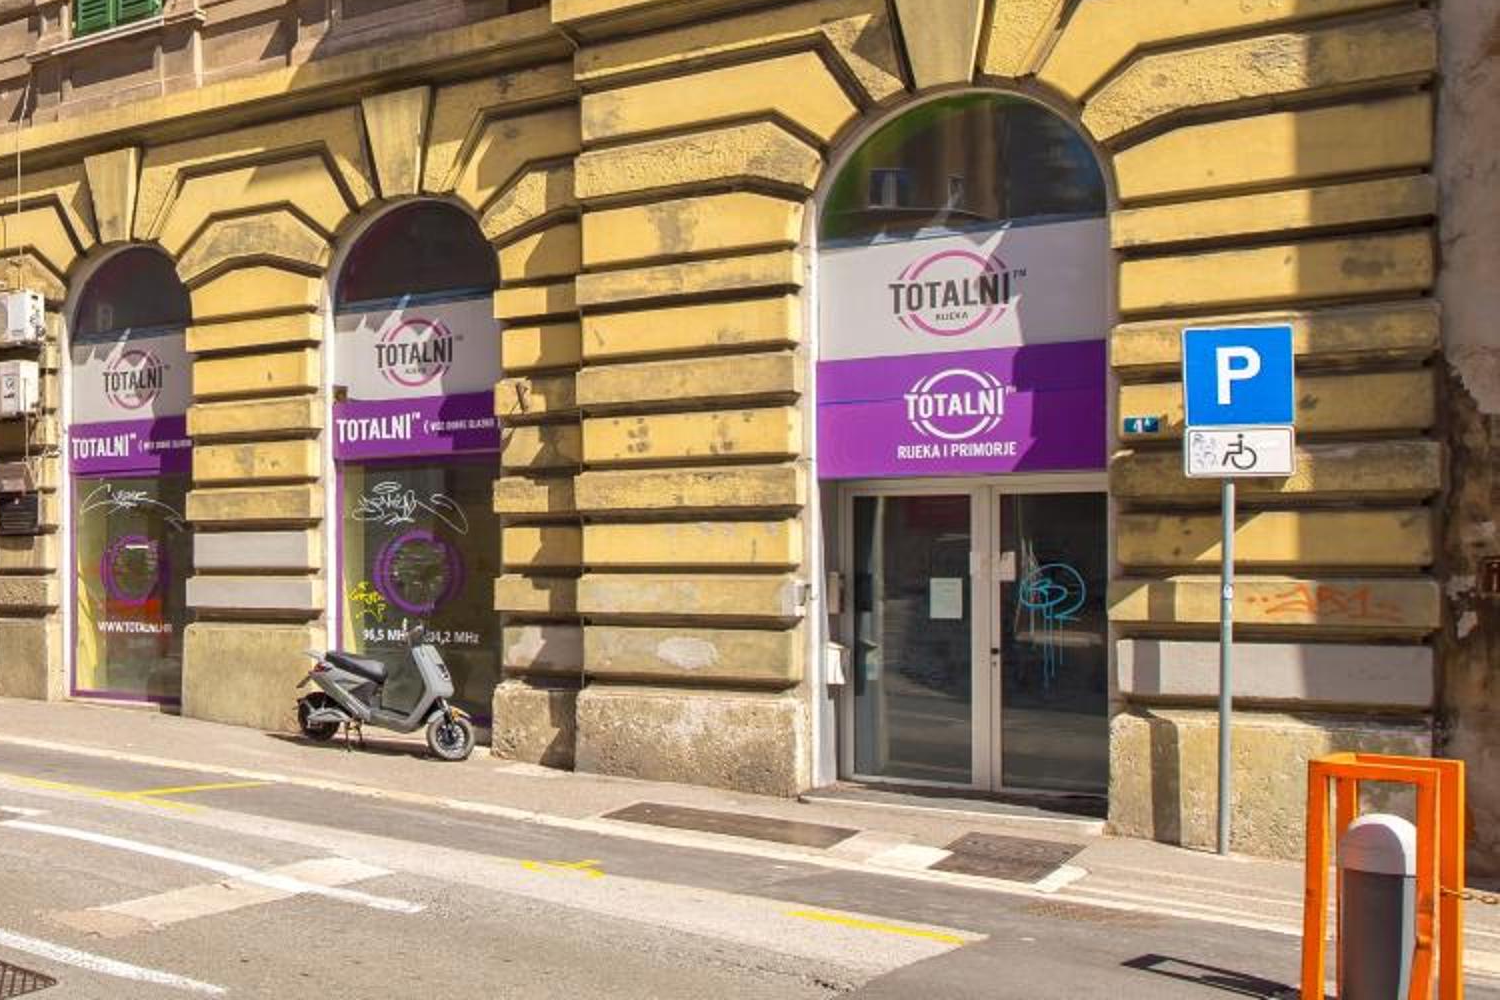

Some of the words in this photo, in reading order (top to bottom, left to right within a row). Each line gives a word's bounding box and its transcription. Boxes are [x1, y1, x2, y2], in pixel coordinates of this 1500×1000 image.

[889, 271, 1011, 314] TOTALNI
[375, 336, 452, 368] TOTALNI
[103, 365, 162, 393] TOTALNI
[1216, 346, 1261, 405] P
[904, 387, 1004, 421] TOTALNI
[336, 413, 411, 443] TOTALNI
[72, 433, 129, 460] TOTALNI
[897, 444, 940, 459] RIJEKA
[951, 441, 1017, 457] PRIMORJE
[387, 629, 408, 641] MH
